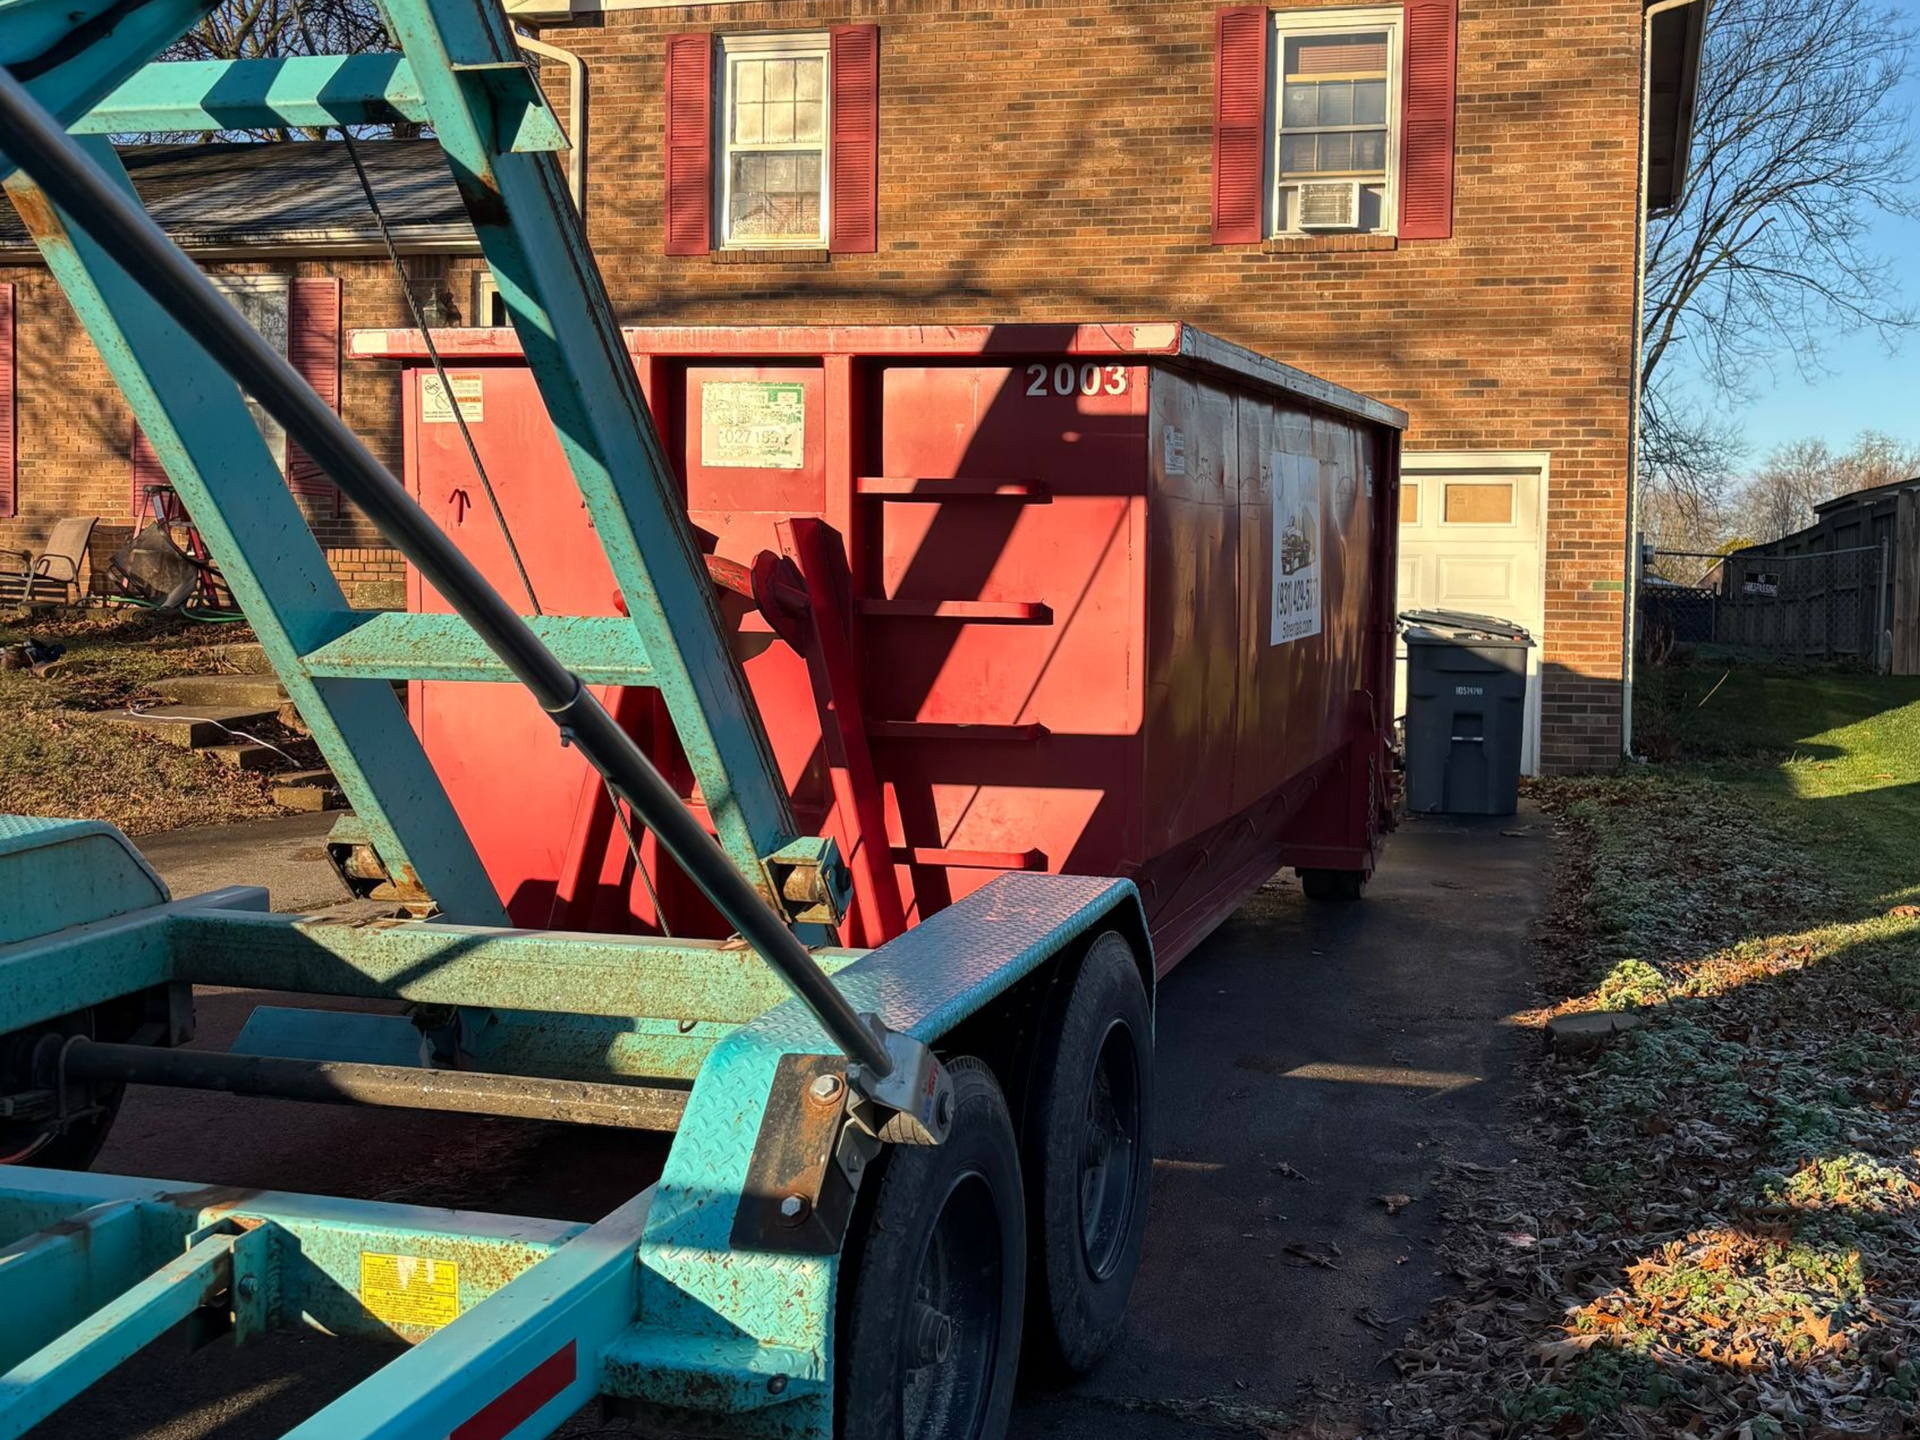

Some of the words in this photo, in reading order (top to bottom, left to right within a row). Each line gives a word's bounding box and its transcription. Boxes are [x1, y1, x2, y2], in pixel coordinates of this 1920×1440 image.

[1026, 362, 1127, 396] 2003
[1758, 573, 1766, 584] NO
[1743, 581, 1778, 595] TRESPASSING
